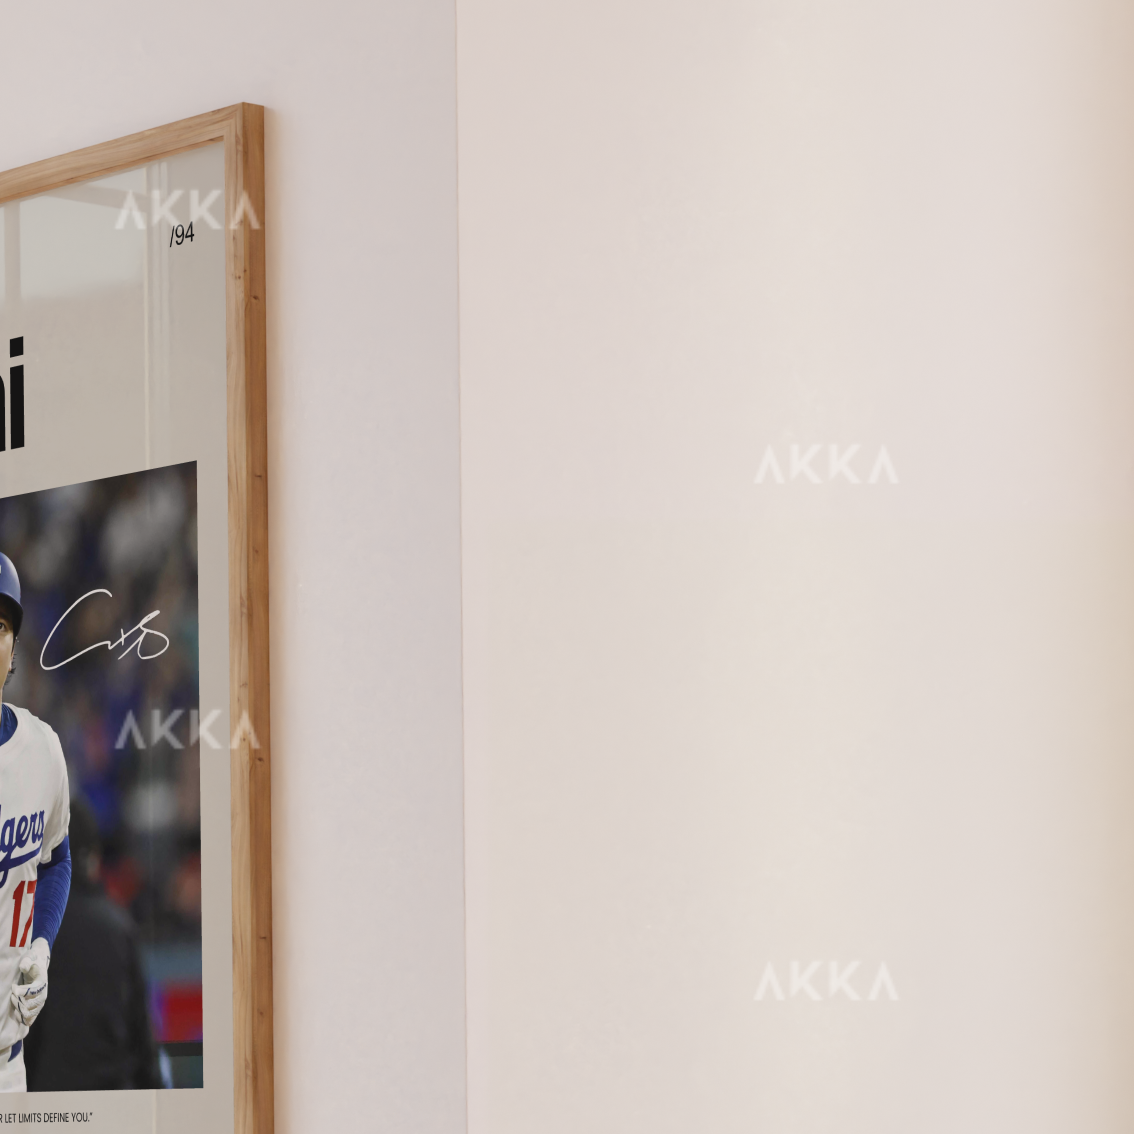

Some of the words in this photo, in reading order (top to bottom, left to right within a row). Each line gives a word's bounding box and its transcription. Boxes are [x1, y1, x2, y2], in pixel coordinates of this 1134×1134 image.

[169, 222, 195, 247] /94
[4, 1113, 16, 1123] LET
[19, 1113, 42, 1123] LIMITS
[44, 1112, 69, 1123] DEFINE
